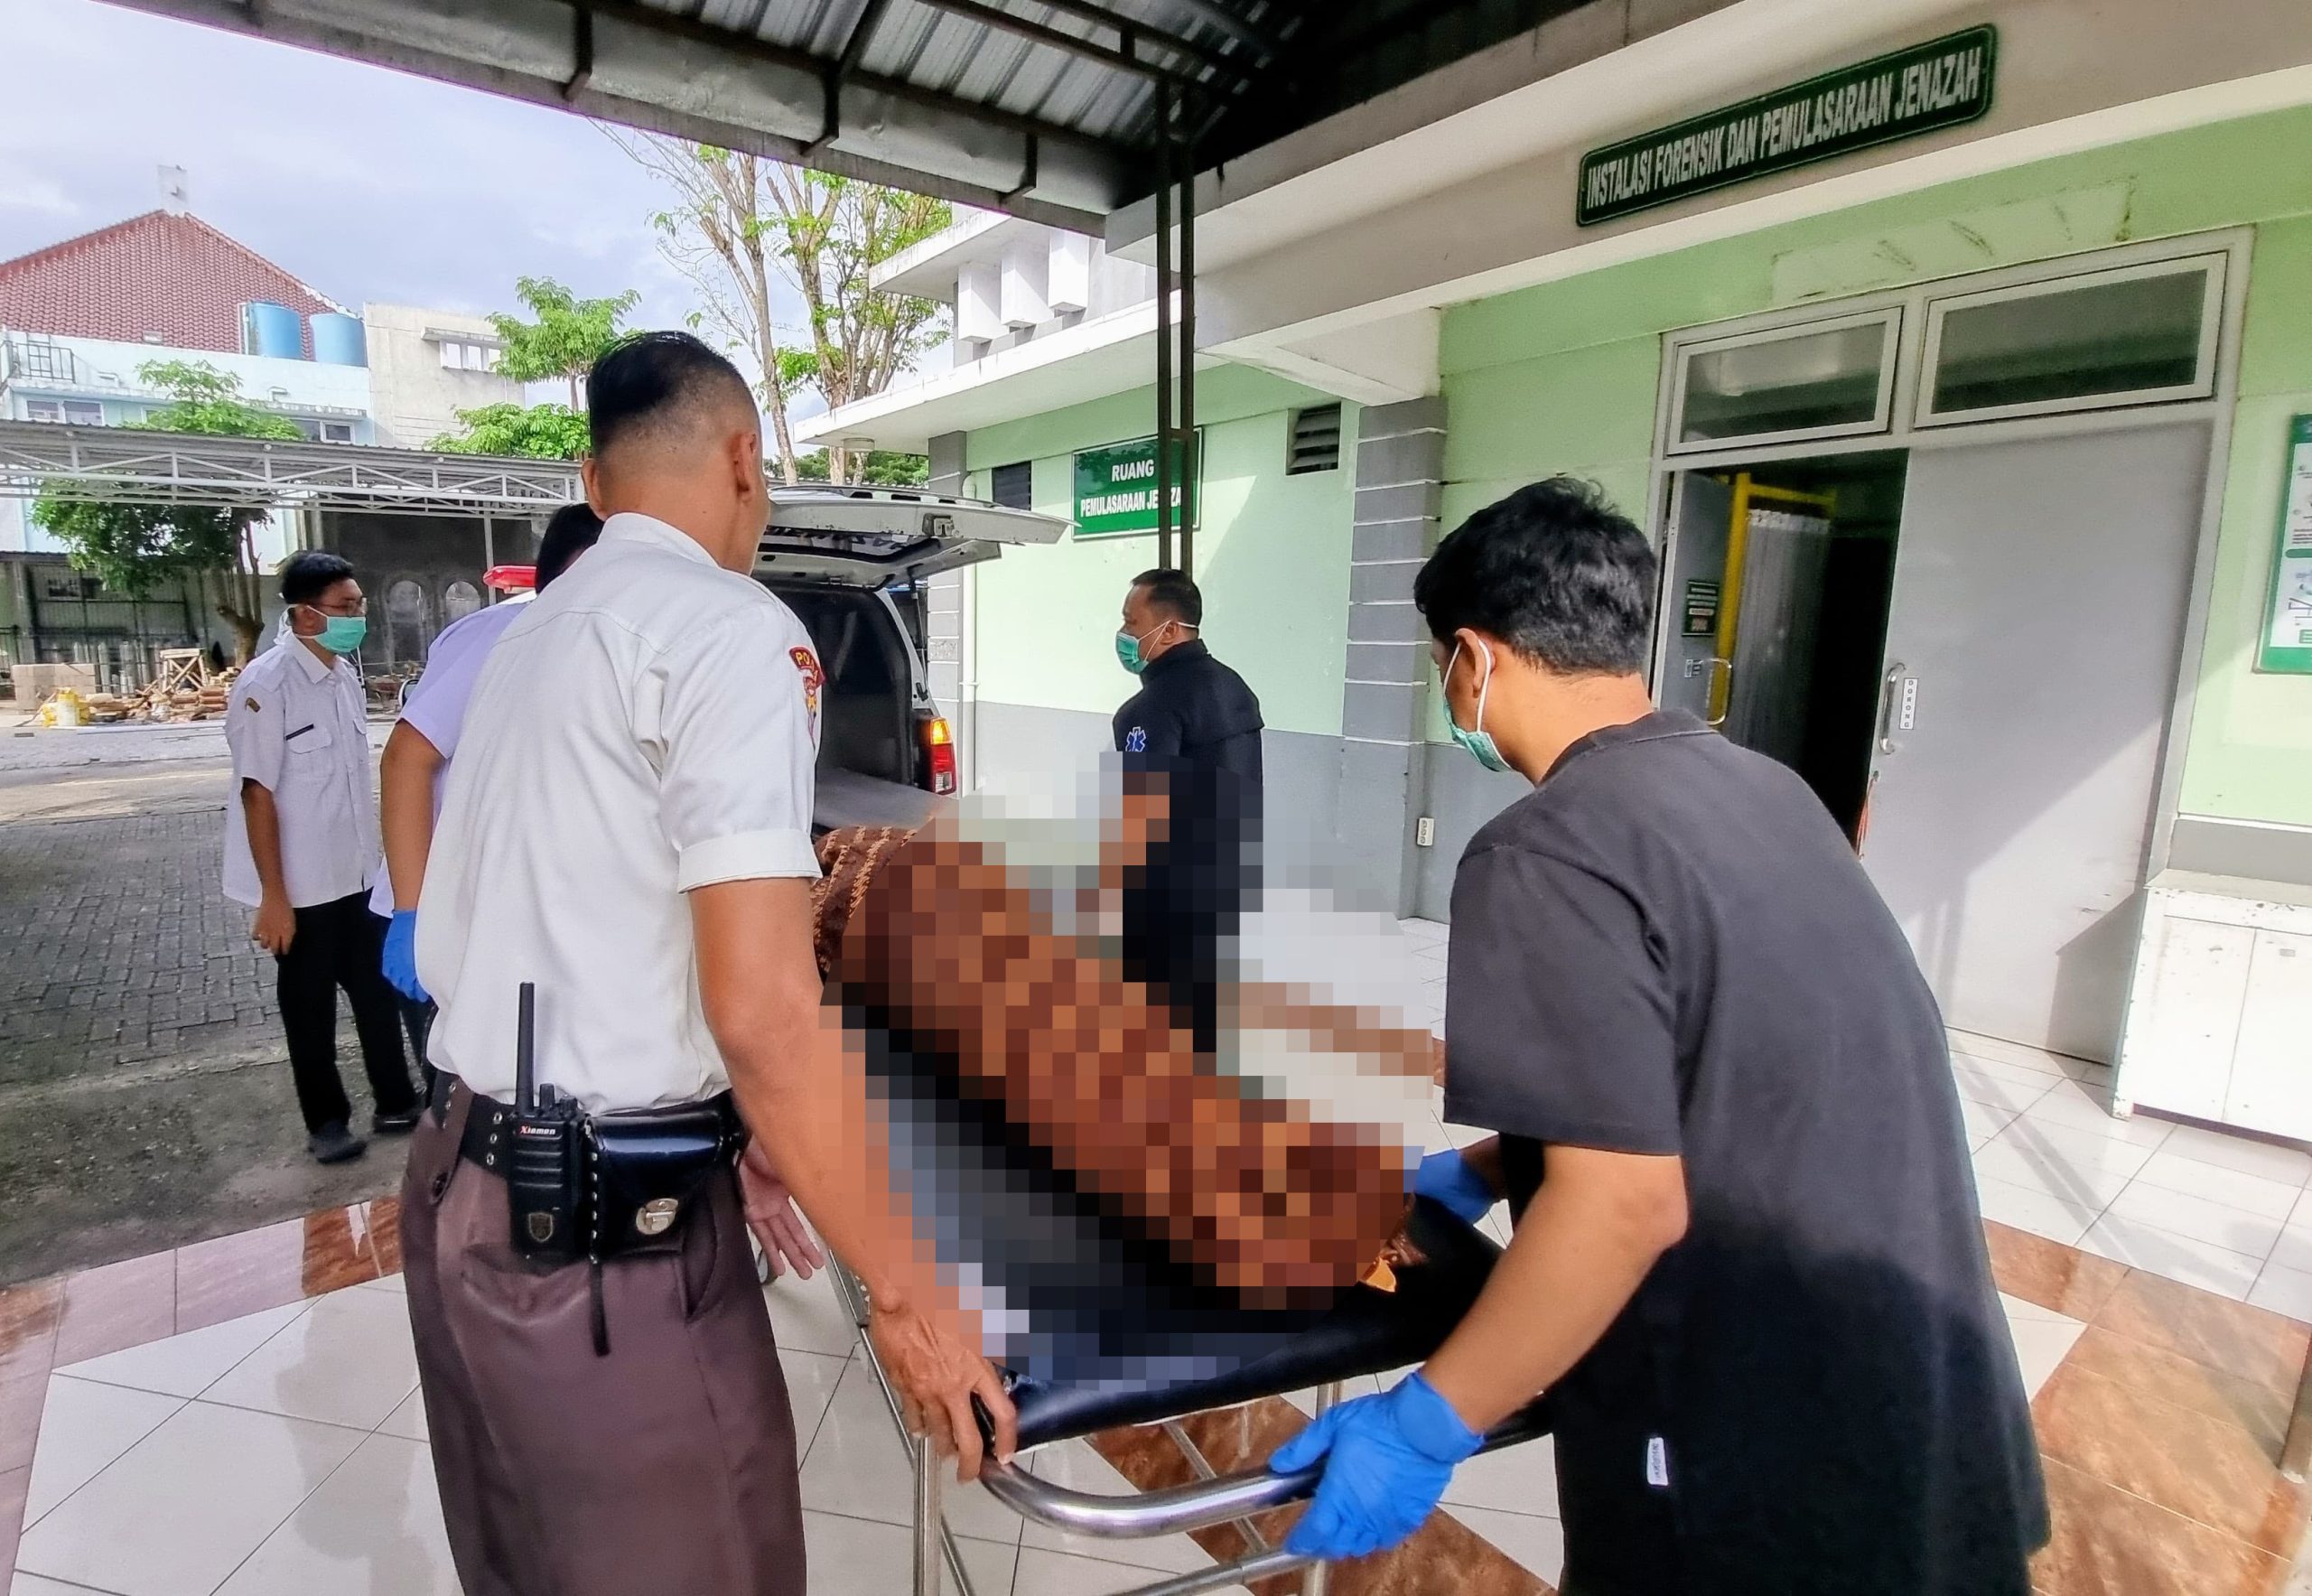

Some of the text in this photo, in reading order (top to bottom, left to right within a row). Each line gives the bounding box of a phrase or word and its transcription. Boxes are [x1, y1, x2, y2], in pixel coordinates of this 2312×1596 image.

[1586, 47, 1981, 209] INSTALASI FORENSIK DAN PEMULASARAAN JENAZAH
[1111, 459, 1154, 482] RUANG
[1080, 486, 1182, 518] PEMULASARAAN JEZA
[1904, 679, 1914, 728] DORONG
